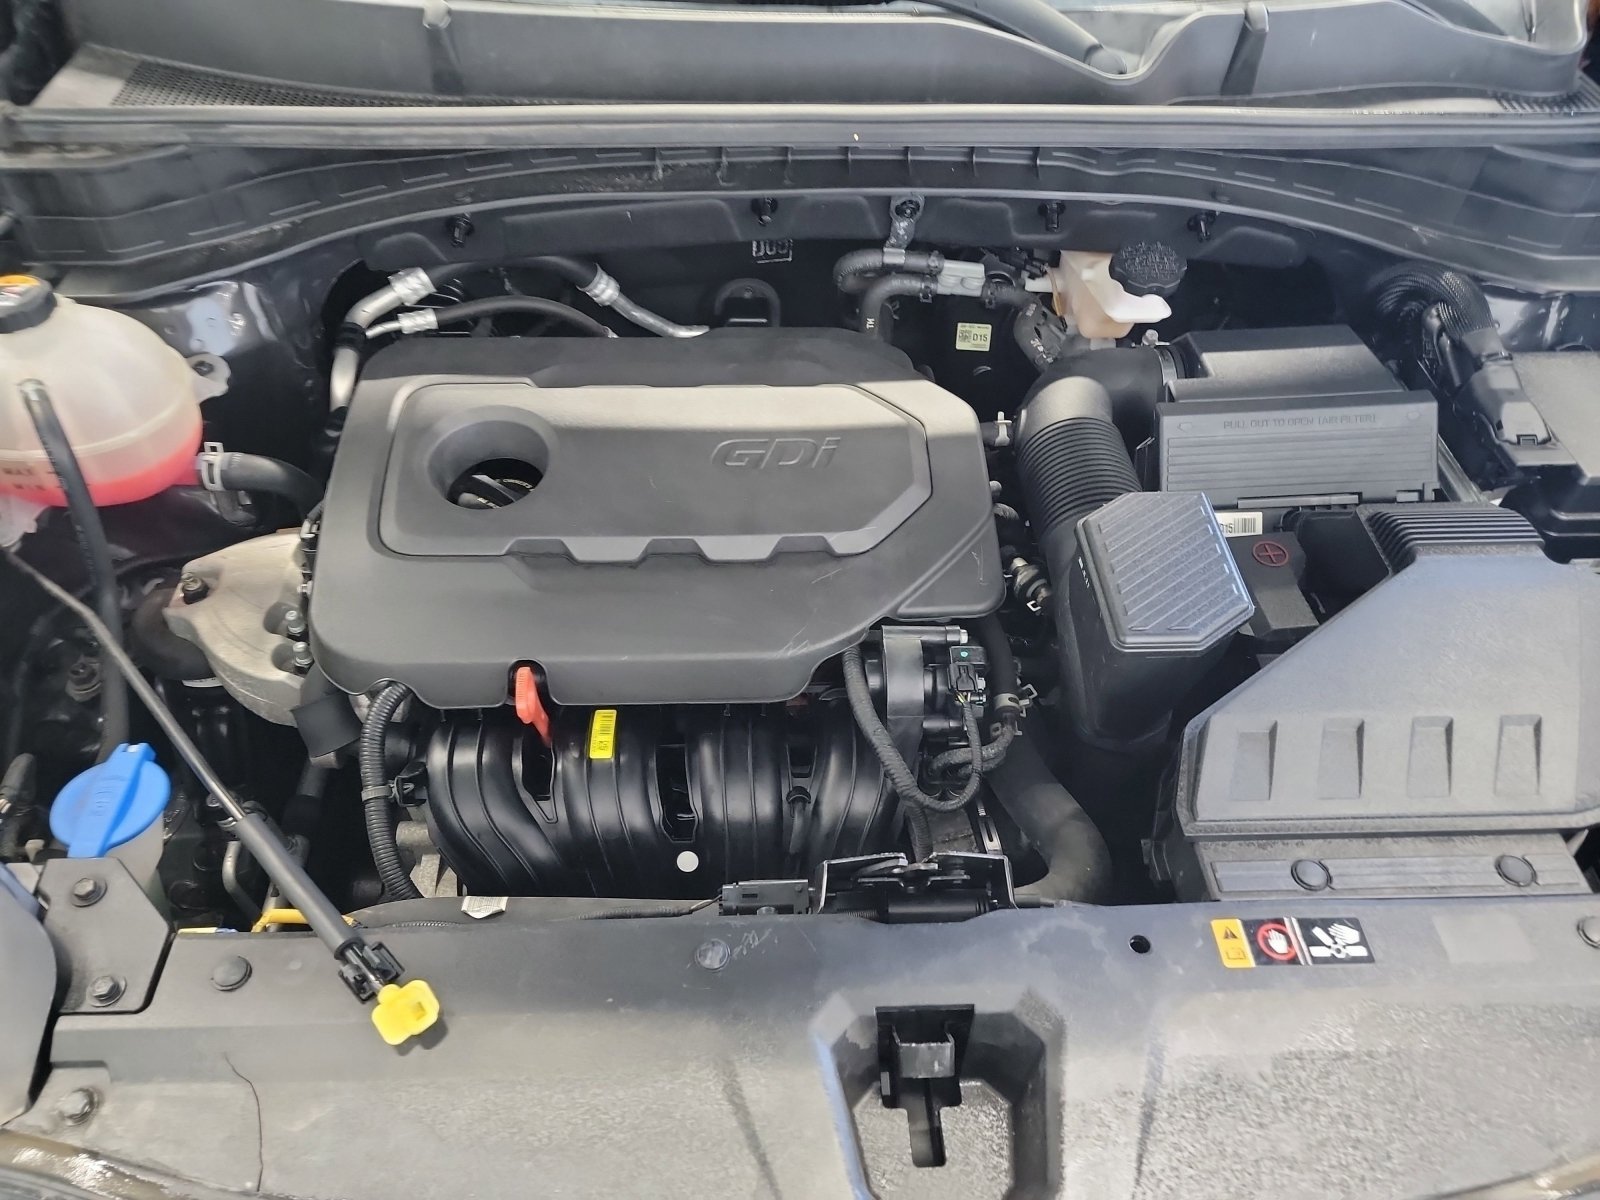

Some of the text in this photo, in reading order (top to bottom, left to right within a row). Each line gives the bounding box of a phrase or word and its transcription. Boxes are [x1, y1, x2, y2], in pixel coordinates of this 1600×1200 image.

[1250, 418, 1270, 428] OUT
[1273, 417, 1285, 427] TO
[1287, 416, 1314, 426] OPEN
[710, 436, 841, 470] GDi
